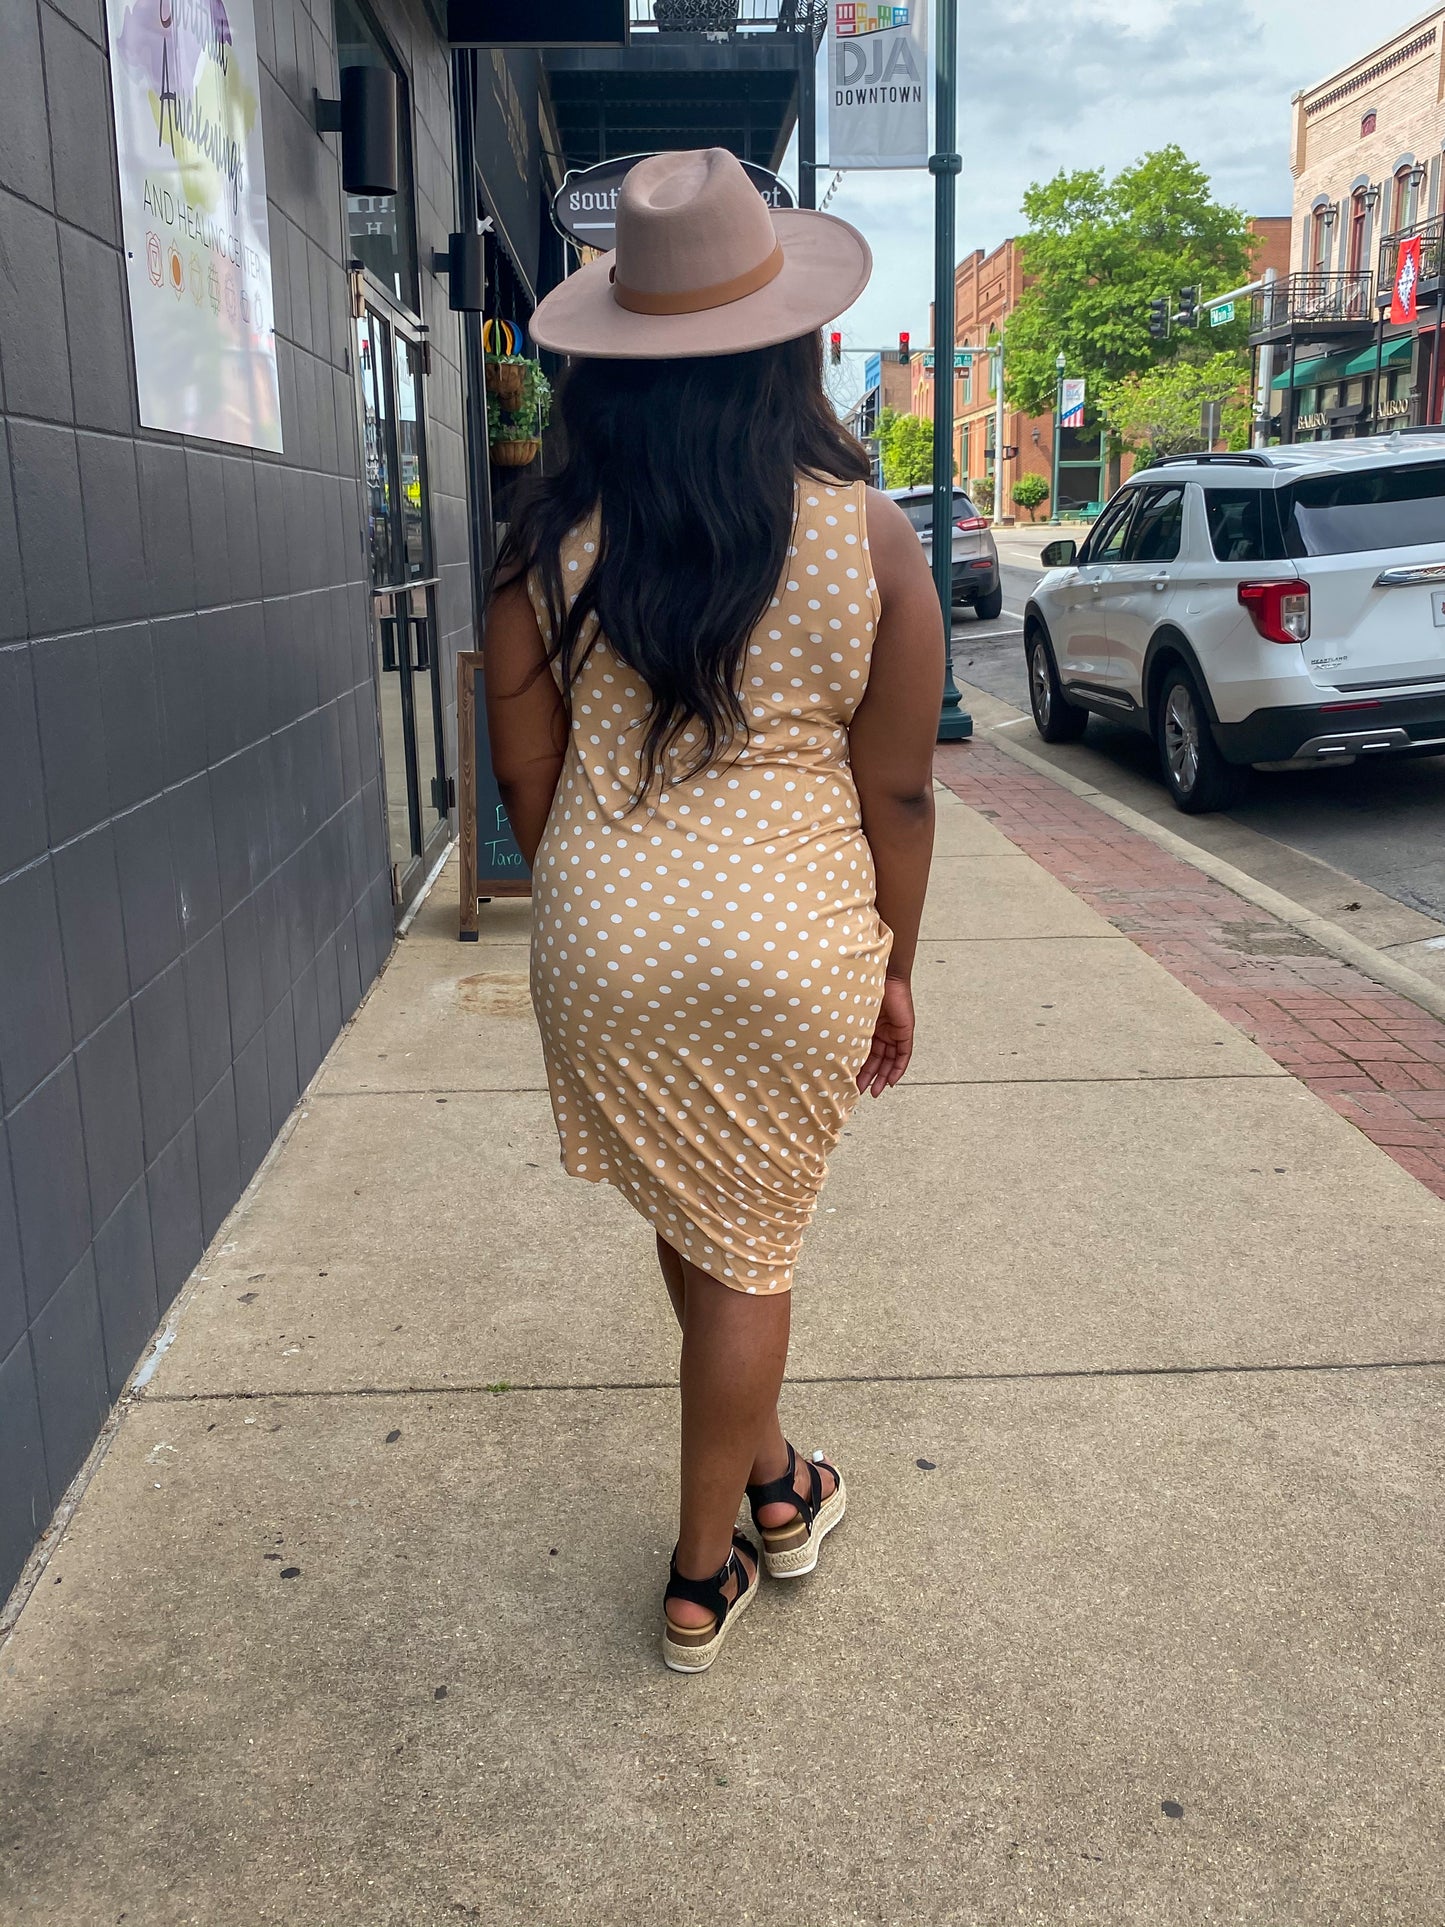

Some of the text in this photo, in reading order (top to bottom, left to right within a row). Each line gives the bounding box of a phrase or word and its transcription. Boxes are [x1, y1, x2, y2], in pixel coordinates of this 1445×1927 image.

[835, 37, 920, 86] DJA
[835, 86, 921, 106] DOWNTOWN
[159, 37, 243, 216] Awakenings
[569, 186, 621, 211] sout
[143, 179, 175, 226] AND
[177, 198, 226, 259] HEALING
[1370, 398, 1409, 419] AMBOO
